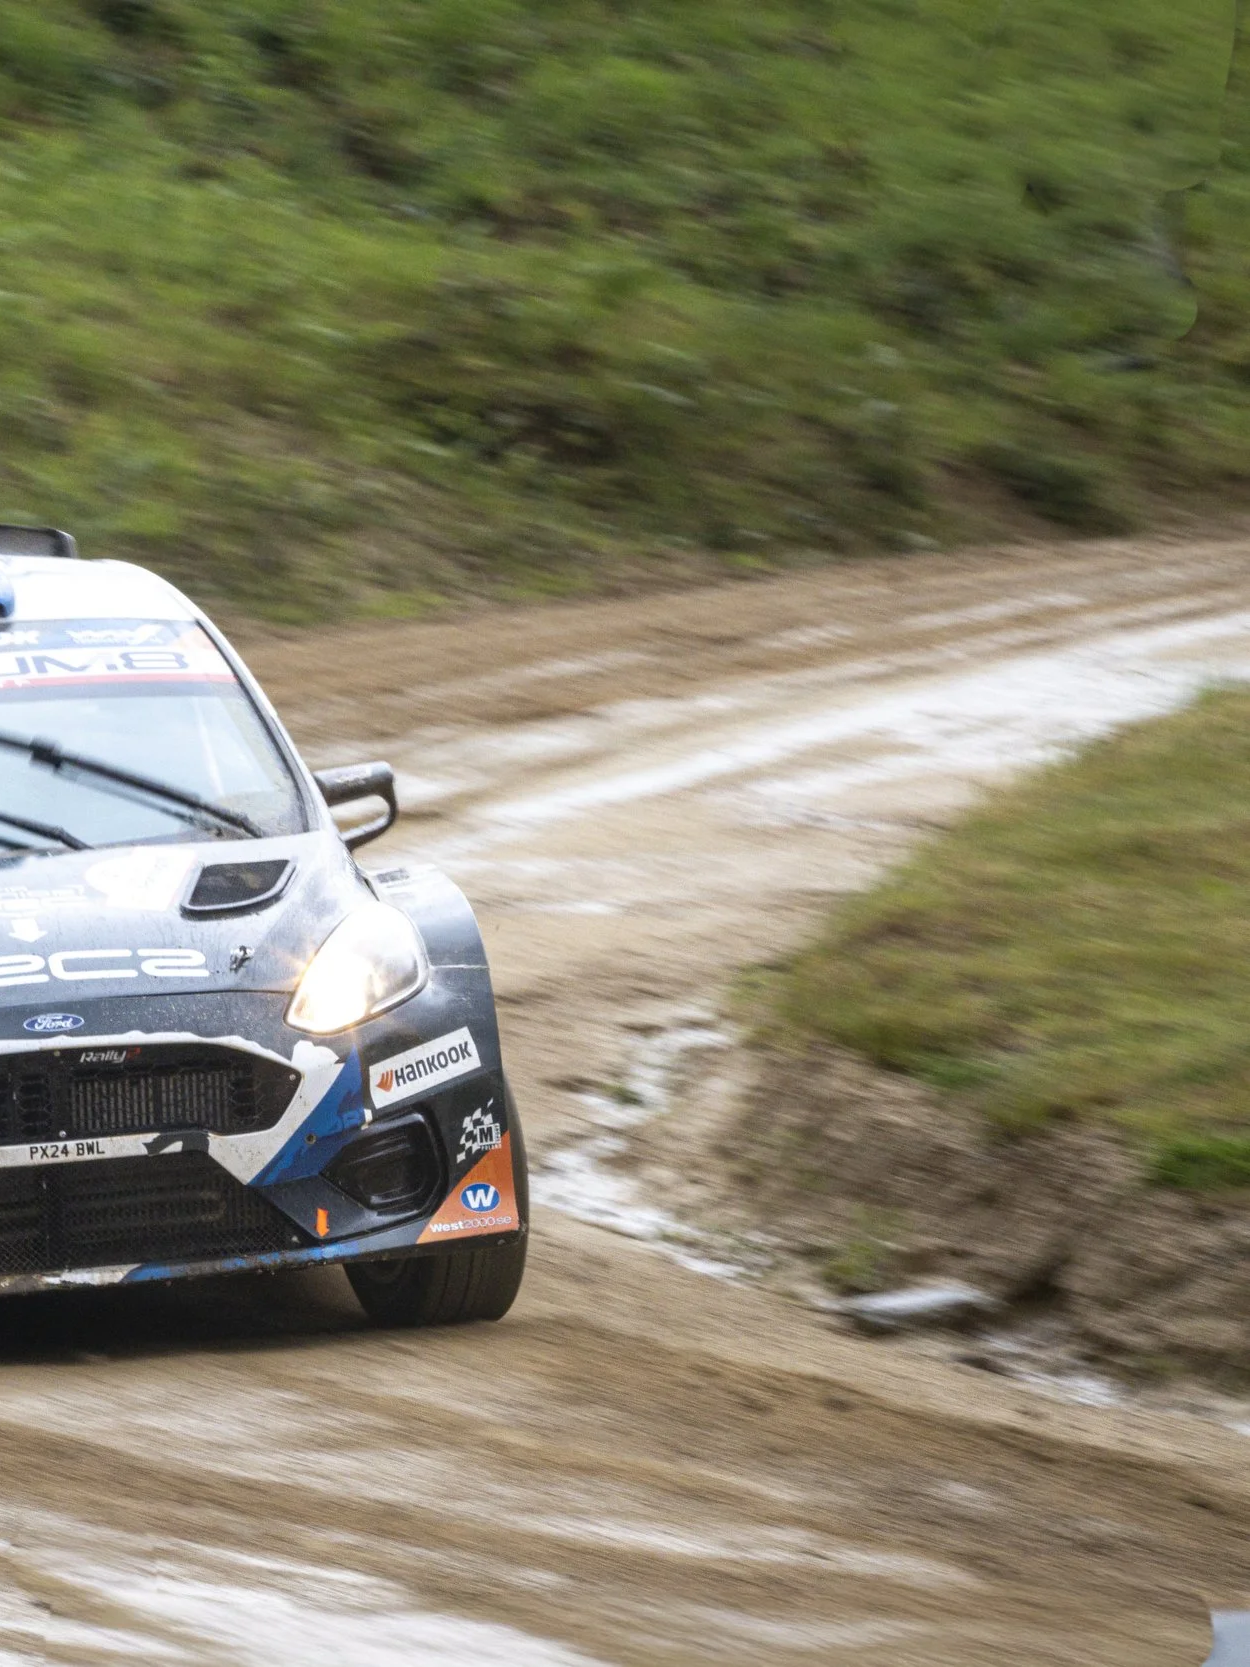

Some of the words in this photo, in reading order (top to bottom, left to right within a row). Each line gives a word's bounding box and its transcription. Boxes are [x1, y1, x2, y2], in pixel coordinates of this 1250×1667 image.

[34, 1014, 74, 1031] Ford
[29, 1144, 70, 1160] PX24
[76, 1141, 105, 1157] BWL
[465, 1185, 496, 1209] W
[429, 1216, 512, 1233] West2000.se
